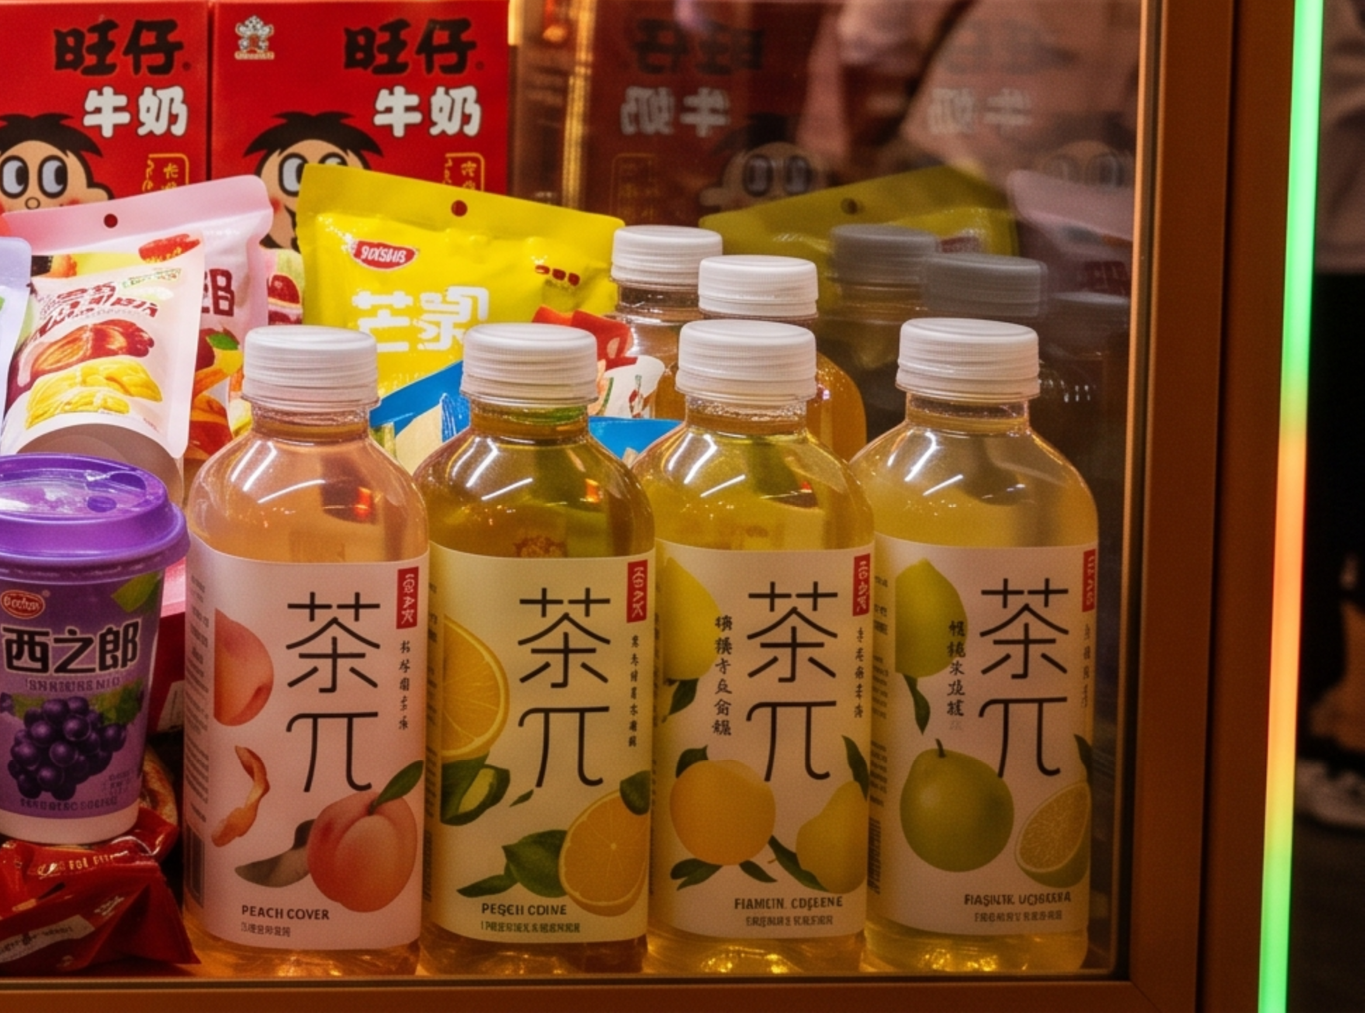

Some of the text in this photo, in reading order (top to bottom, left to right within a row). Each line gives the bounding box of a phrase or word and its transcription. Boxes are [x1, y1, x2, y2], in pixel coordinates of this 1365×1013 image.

[53, 18, 183, 77] 旺仔
[343, 18, 477, 77] 旺仔
[83, 86, 188, 137] 牛奶
[374, 86, 481, 137] 牛奶
[2, 619, 140, 674] 西之郎
[241, 904, 330, 920] PEACH COVER
